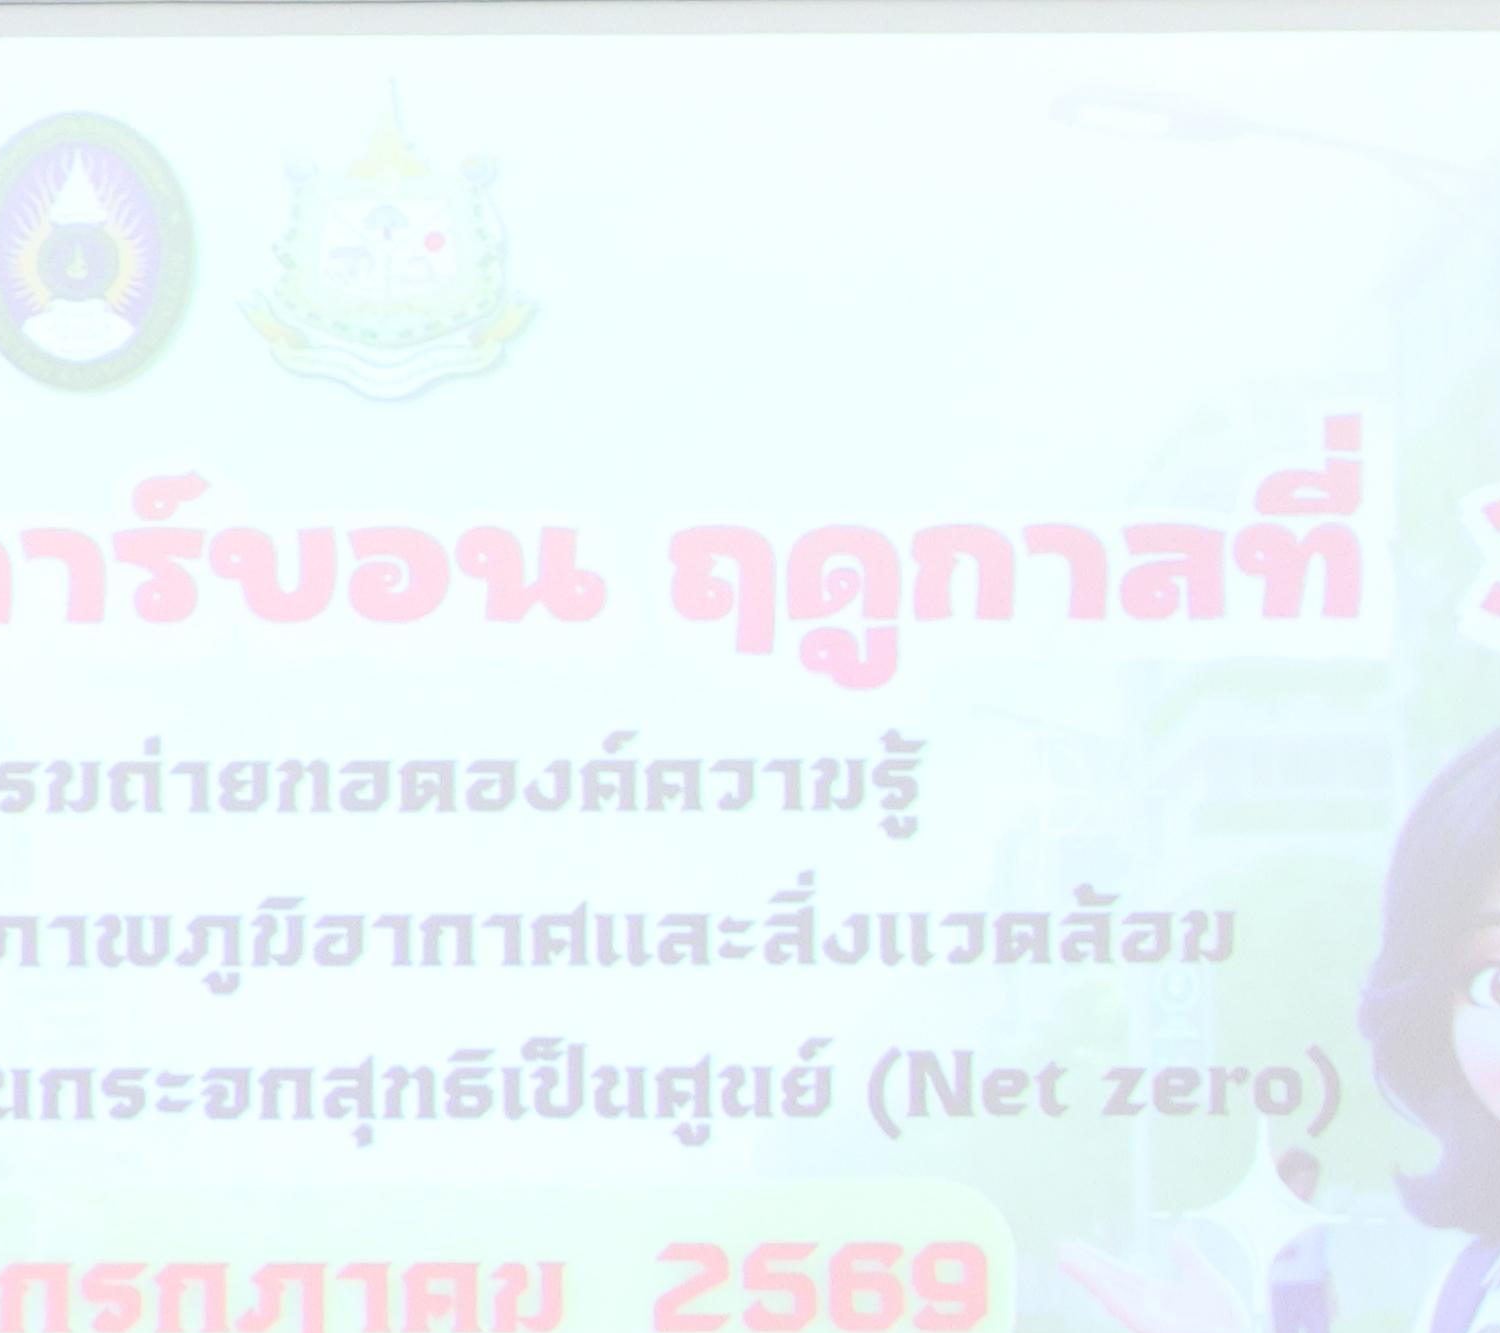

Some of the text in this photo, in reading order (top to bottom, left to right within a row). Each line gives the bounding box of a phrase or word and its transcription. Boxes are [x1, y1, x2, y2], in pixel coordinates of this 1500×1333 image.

[667, 411, 1364, 691] ฤดูกาลที่
[866, 1049, 1067, 1136] (Net
[1099, 1049, 1344, 1136] zero)
